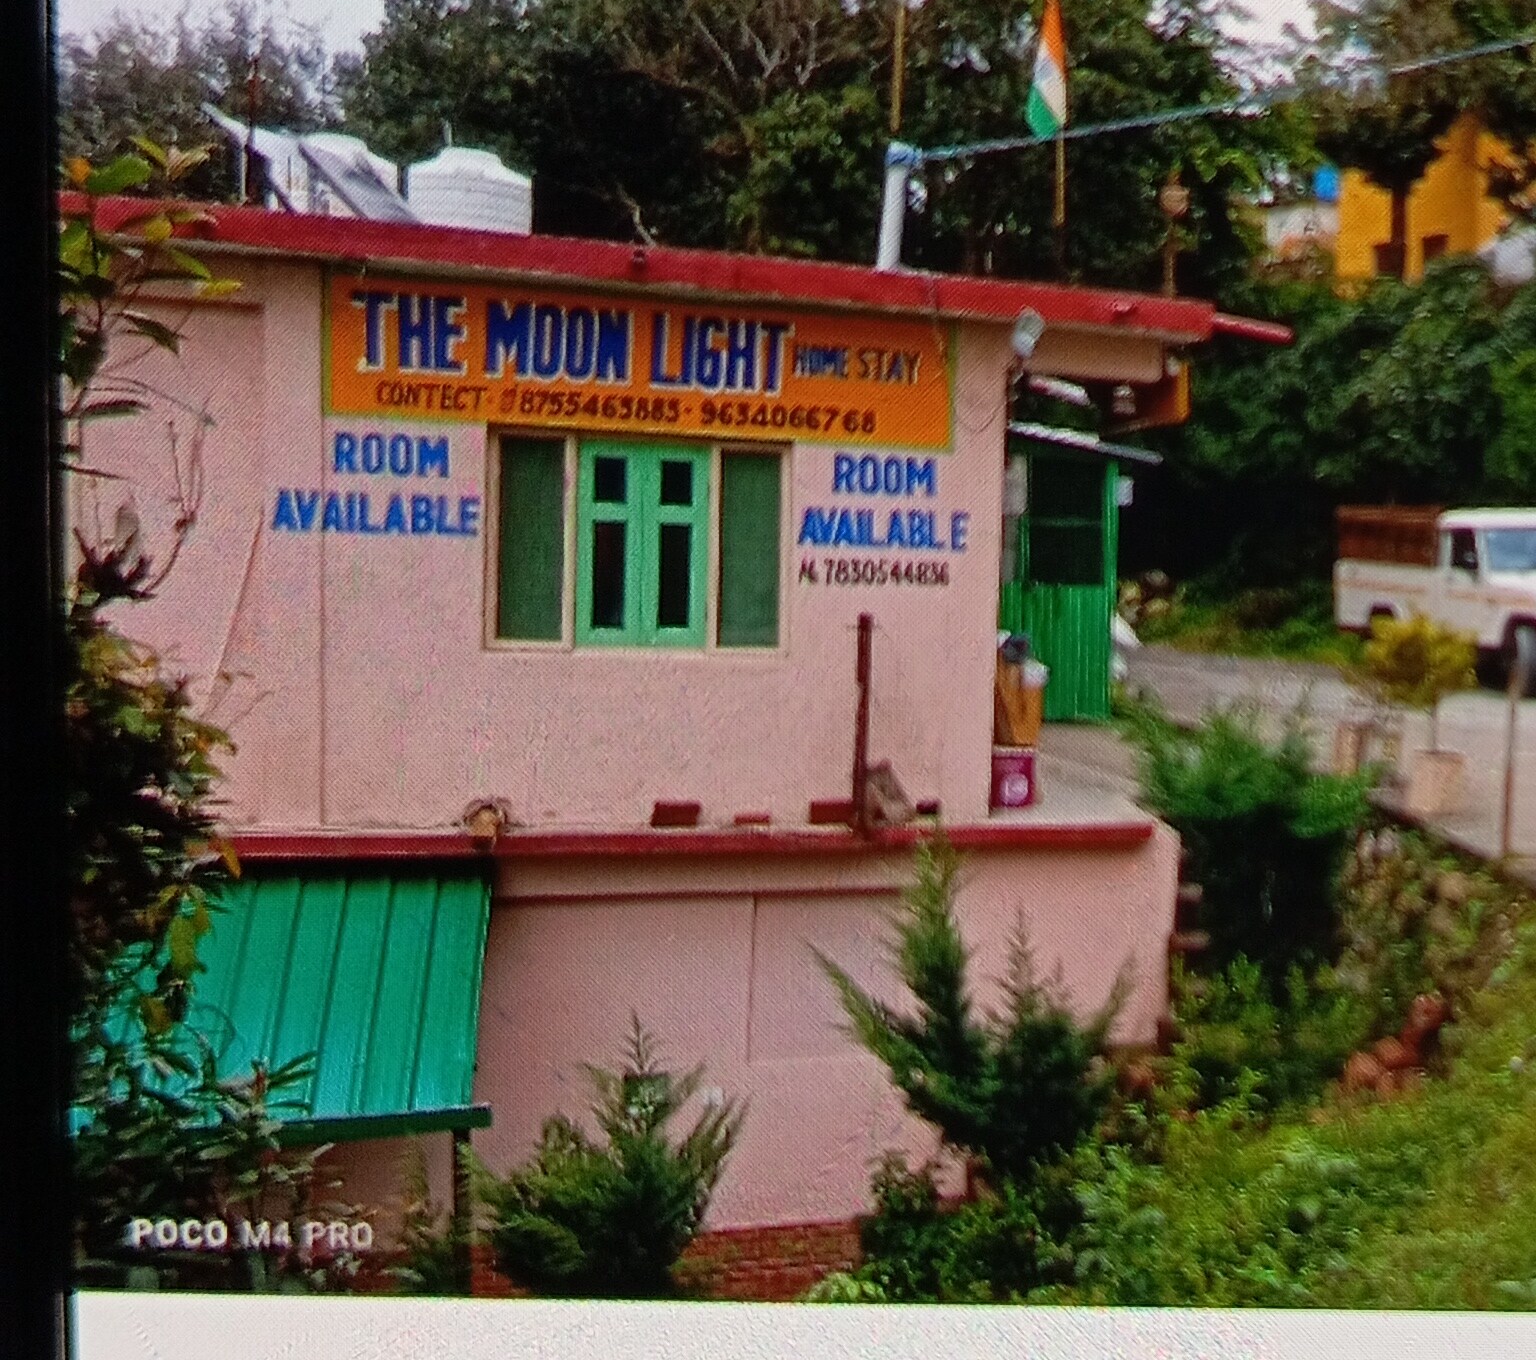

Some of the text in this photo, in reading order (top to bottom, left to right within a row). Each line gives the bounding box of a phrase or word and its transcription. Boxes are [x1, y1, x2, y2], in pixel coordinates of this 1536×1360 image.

[352, 292, 467, 374] THE
[485, 299, 634, 385] MOON
[650, 309, 796, 397] LIGHT
[858, 349, 922, 385] STAY
[334, 431, 450, 479] ROOM
[833, 451, 938, 497] ROOM
[272, 488, 481, 536] AVAILABLE
[798, 505, 971, 554] AVAILABLE
